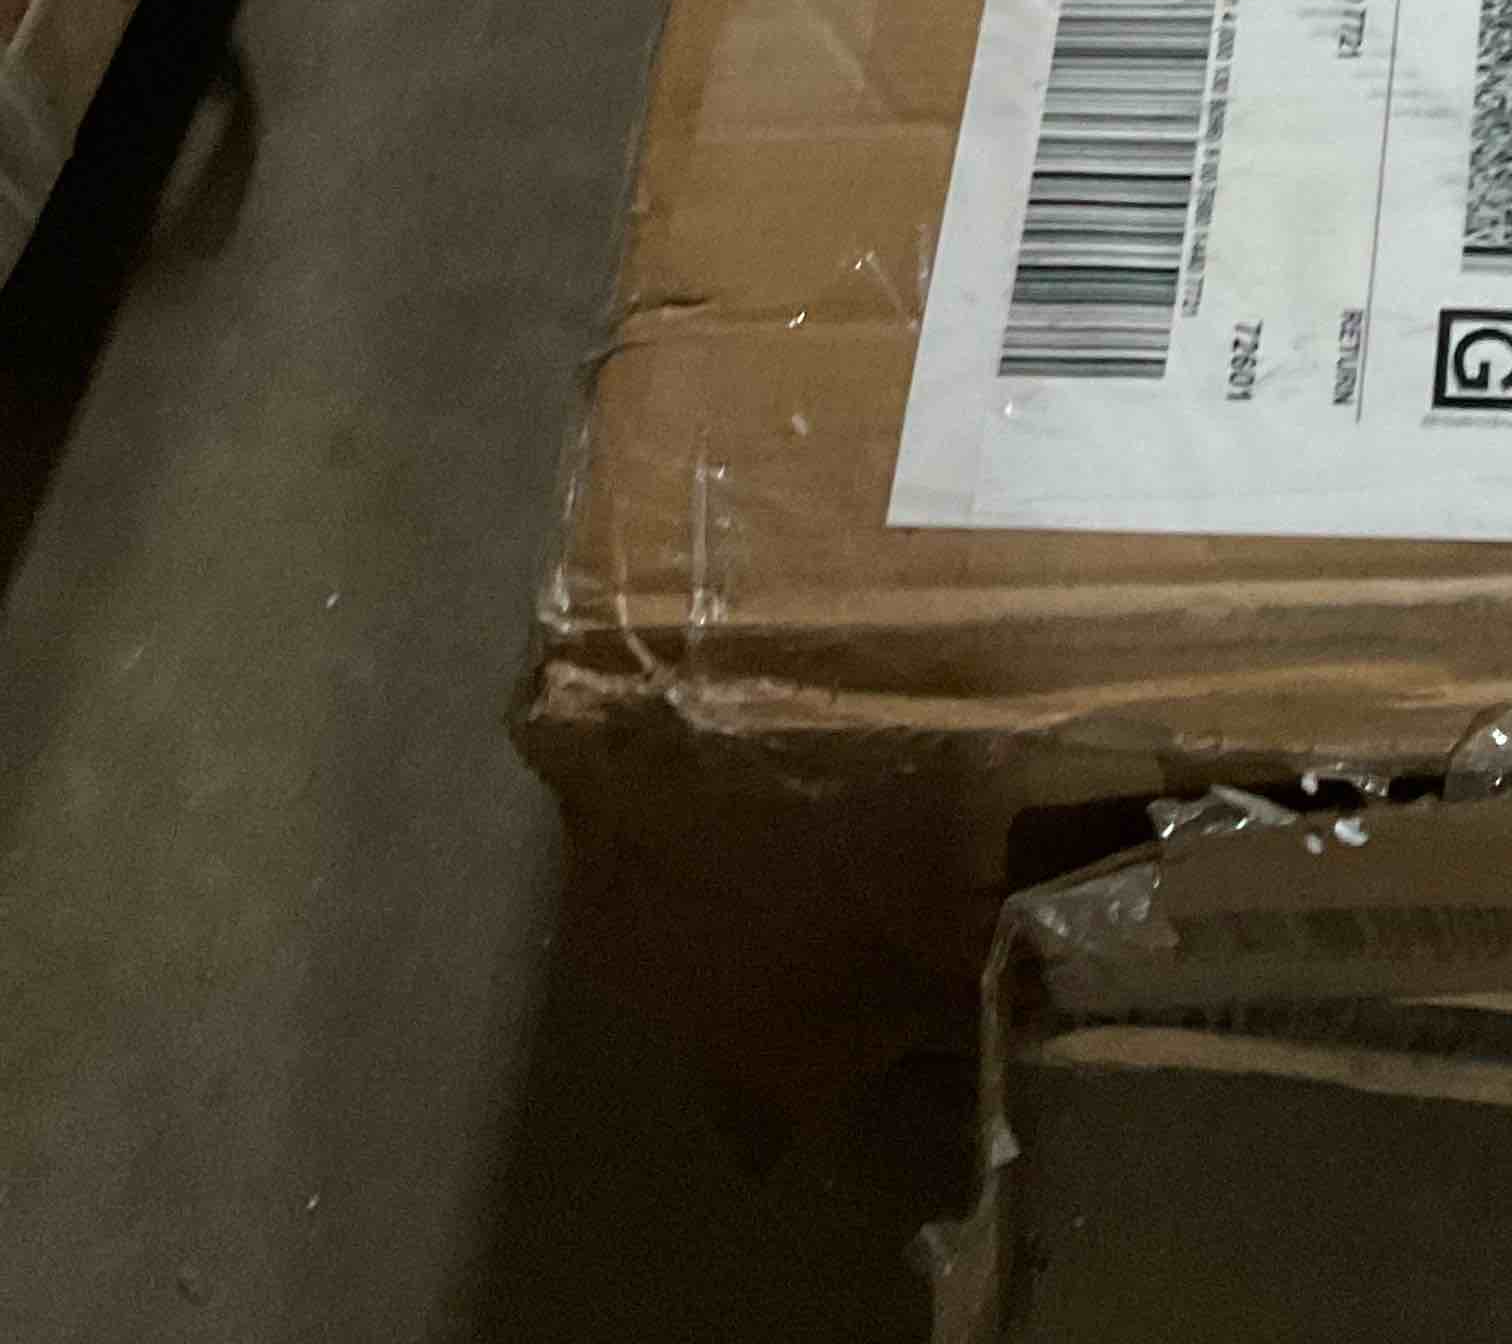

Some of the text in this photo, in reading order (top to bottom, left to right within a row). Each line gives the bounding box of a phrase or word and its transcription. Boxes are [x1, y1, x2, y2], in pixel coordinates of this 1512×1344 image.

[1335, 8, 1367, 60] 7721
[1225, 318, 1266, 404] 72601
[1331, 308, 1364, 406] RETURN
